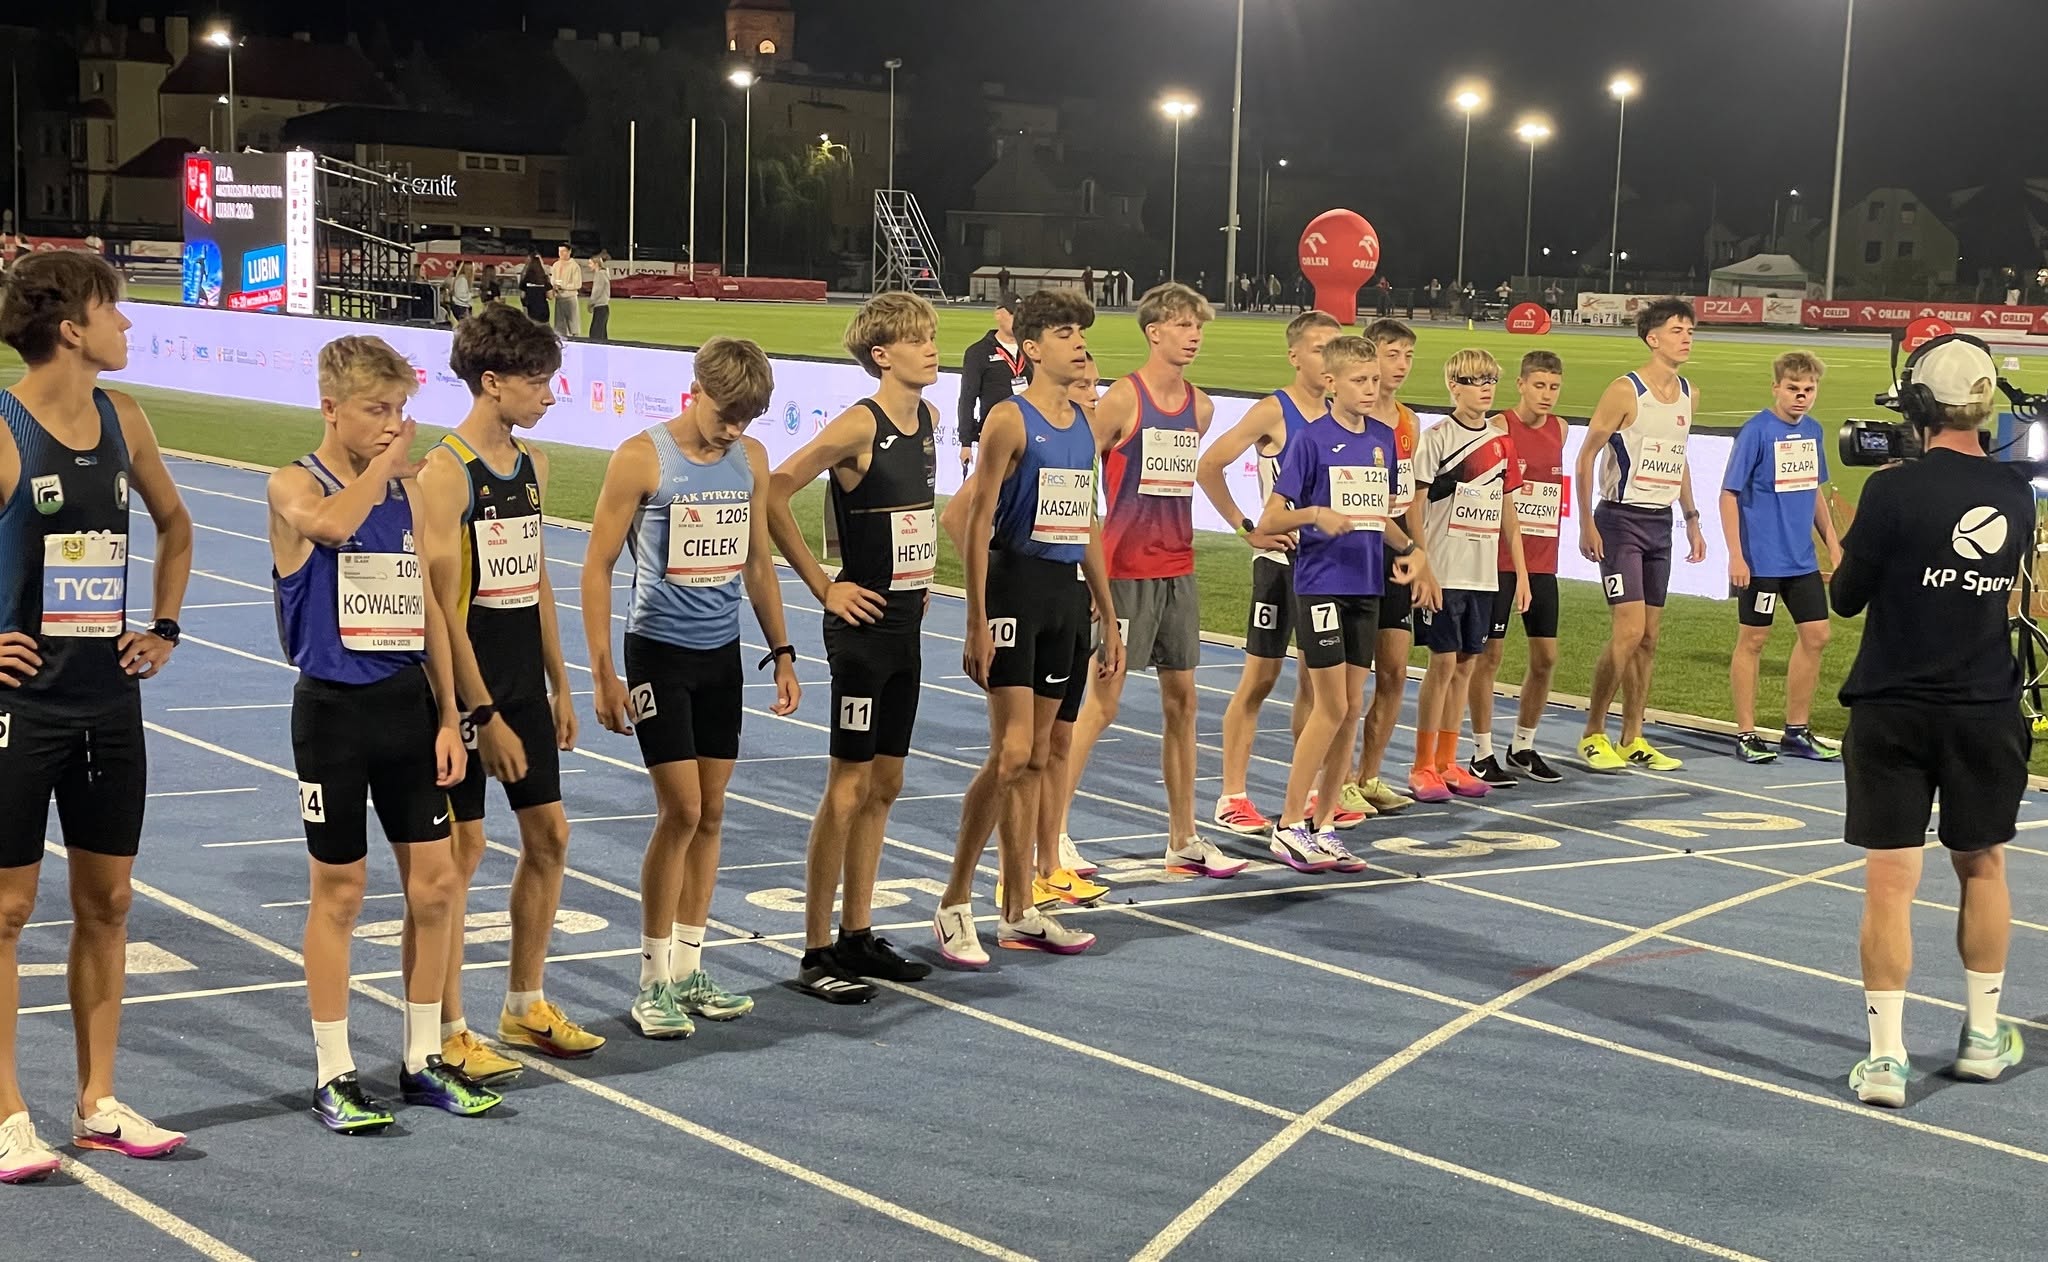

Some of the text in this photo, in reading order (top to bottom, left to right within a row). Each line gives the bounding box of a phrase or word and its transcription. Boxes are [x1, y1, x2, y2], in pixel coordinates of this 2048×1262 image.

[1302, 257, 1329, 266] ORLEN
[248, 255, 280, 284] LUBIN
[1703, 301, 1753, 314] PZLA
[1825, 309, 1848, 317] ORLEN
[1879, 309, 1911, 319] ORLEN
[1937, 310, 1972, 321] ORLEN
[2003, 314, 2030, 322] ORLEN
[1173, 434, 1197, 448] 1031
[1801, 442, 1814, 452] 972
[1146, 455, 1197, 473] GOLIŃSKI
[1641, 459, 1683, 474] PAWLAK
[1781, 460, 1814, 473] SZŁAPA
[1074, 474, 1090, 488] 704
[1364, 470, 1387, 485] 1214
[672, 491, 750, 504] ŻAK PYRZYCE
[1542, 486, 1558, 497] 896
[1040, 499, 1090, 517] KASZANY
[1342, 493, 1384, 508] BOREK
[716, 507, 748, 524] 1205
[1455, 506, 1500, 521] GMYREK
[1513, 502, 1558, 518] SZCZĘSNY
[683, 537, 738, 556] CIELEK
[488, 552, 538, 577] WOLAK
[1922, 567, 1957, 588] KP
[1608, 577, 1618, 595] 2
[343, 594, 423, 615] KOWALEWSKI
[1763, 595, 1772, 611] 1
[1259, 606, 1270, 626] 6
[1317, 606, 1331, 628] 7
[76, 625, 105, 633] LUBIN
[990, 622, 1014, 642] 10
[632, 690, 654, 718] 12
[844, 702, 868, 725] 11
[299, 788, 321, 815] 14
